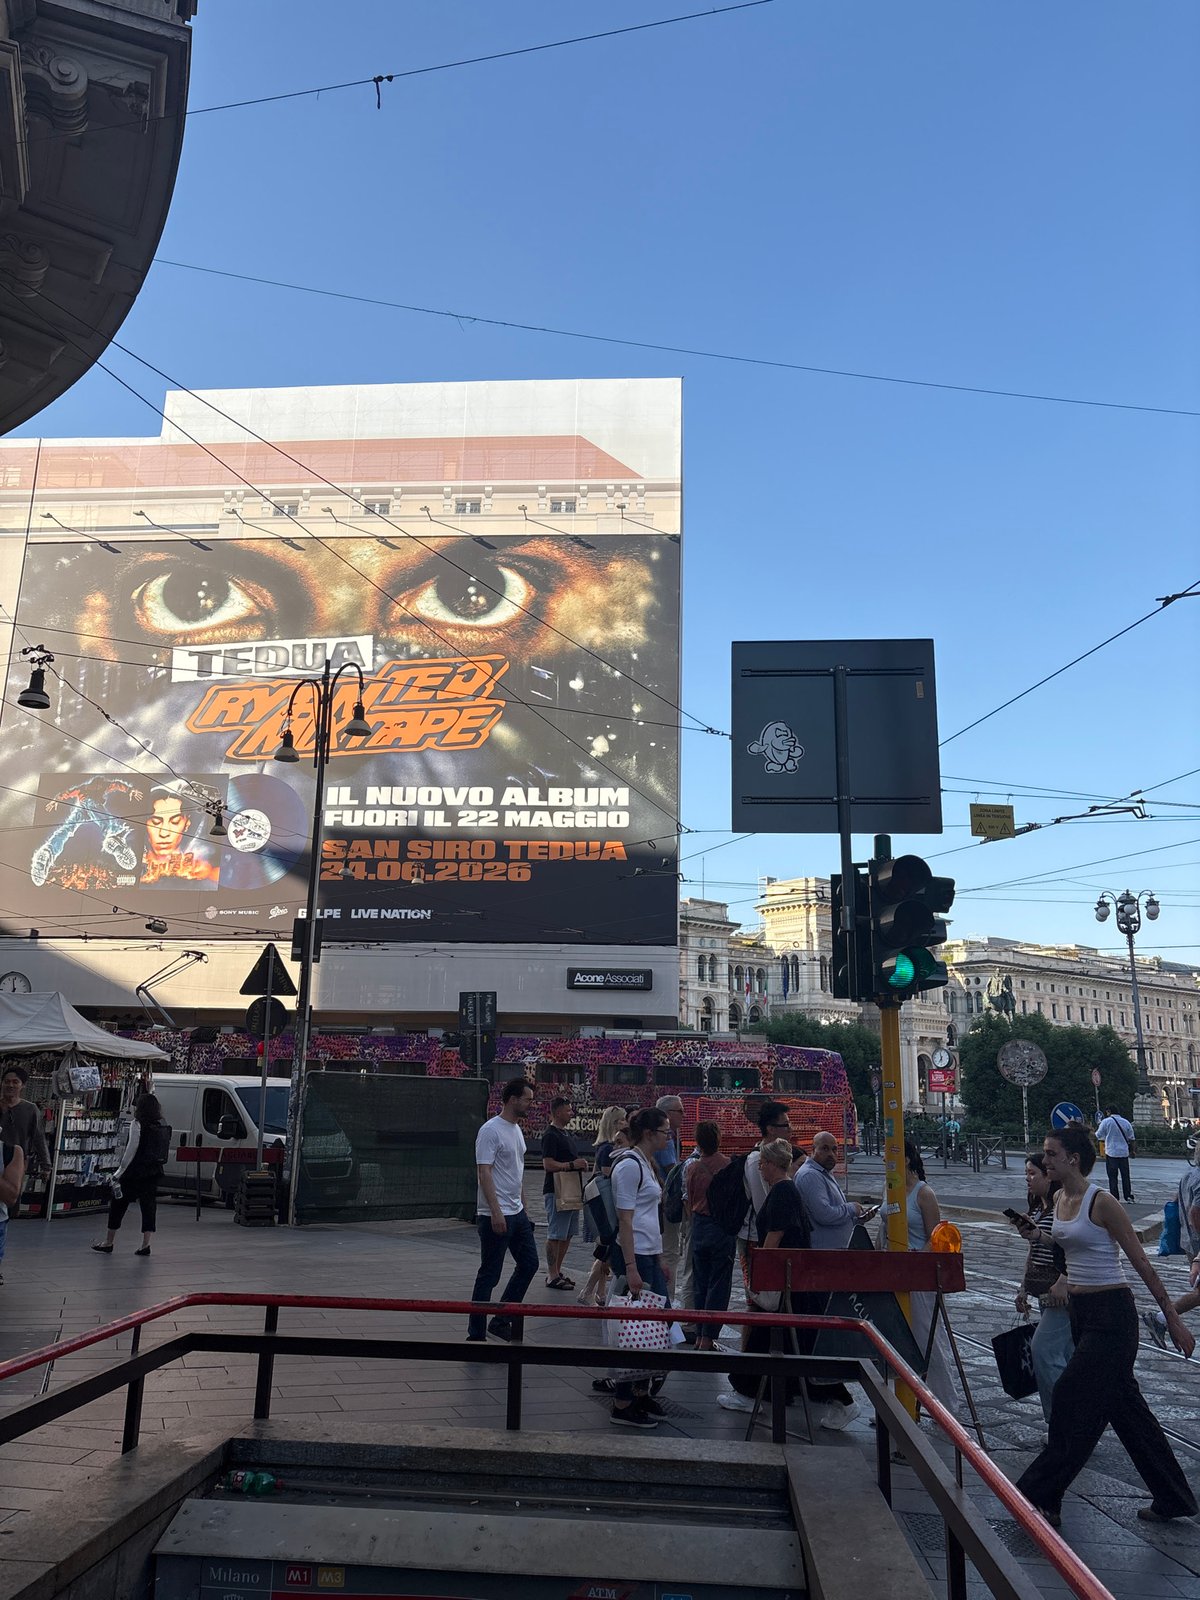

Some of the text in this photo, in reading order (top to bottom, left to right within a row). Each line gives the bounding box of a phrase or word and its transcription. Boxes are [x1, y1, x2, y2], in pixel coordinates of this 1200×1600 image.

[189, 640, 365, 677] TEDUA
[326, 786, 629, 806] IL NUOVO ALBUM
[324, 810, 629, 828] FUORI IL 22 MAGGIO
[322, 839, 628, 860] SAN SIRO TEDUA
[320, 861, 532, 881] 24.06.2026
[297, 908, 341, 919] GLPE
[351, 908, 431, 919] LIVE NATION
[574, 972, 645, 983] Acone Associati
[209, 1566, 261, 1584] Milano
[288, 1569, 341, 1582] M1 M3
[588, 1587, 617, 1600] ATM
